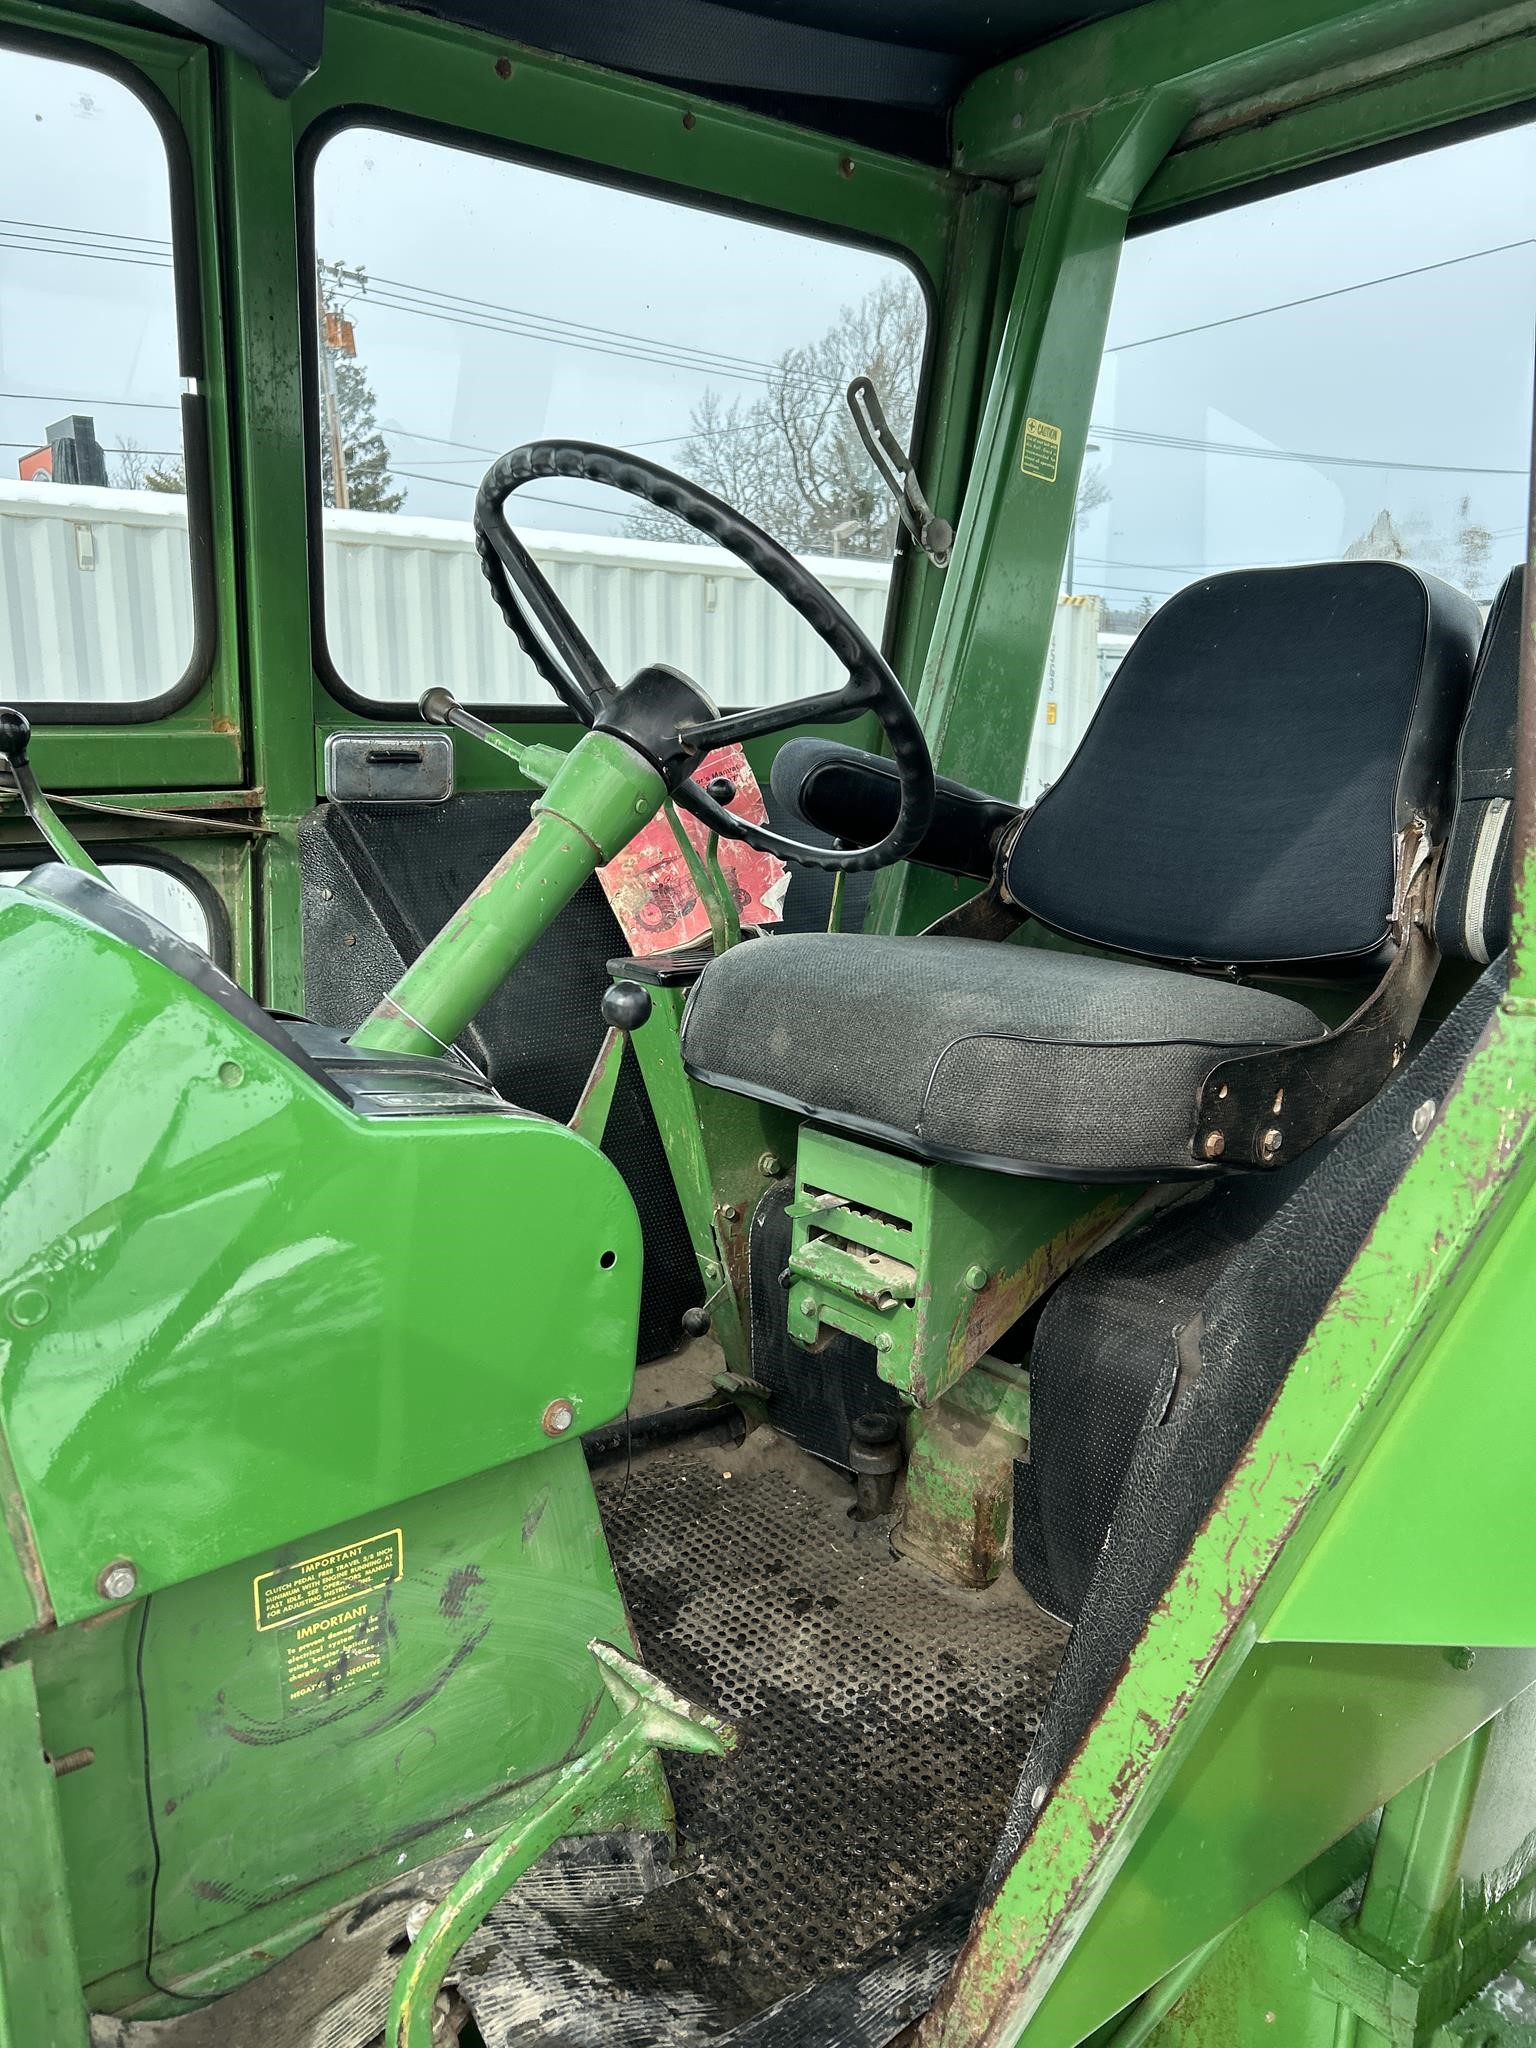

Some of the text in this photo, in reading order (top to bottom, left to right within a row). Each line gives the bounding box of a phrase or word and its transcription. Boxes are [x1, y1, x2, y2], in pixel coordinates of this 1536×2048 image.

[265, 1582, 292, 1597] CLUTCH
[293, 1574, 316, 1587] PEDAL
[318, 1568, 334, 1578] FREE
[335, 1559, 360, 1572] TRAVEL
[376, 1547, 393, 1557] INCH
[301, 1547, 363, 1575] IMPORTANT
[265, 1554, 393, 1604] MINIMUM WITH ENGINE RUNNING AT
[266, 1600, 283, 1611] FAST
[307, 1588, 319, 1597] SEE
[322, 1573, 362, 1591] OPERORS
[365, 1561, 393, 1576] MANUAL
[266, 1609, 281, 1619] FOR
[282, 1594, 322, 1613] ADJUSTING
[296, 1604, 368, 1640] IMPORTANT
[288, 1645, 324, 1665] electrical
[328, 1635, 354, 1649] system
[298, 1637, 325, 1653] prevent
[288, 1661, 309, 1673] using
[312, 1649, 340, 1664] booster
[346, 1657, 381, 1677] NEGATIVE
